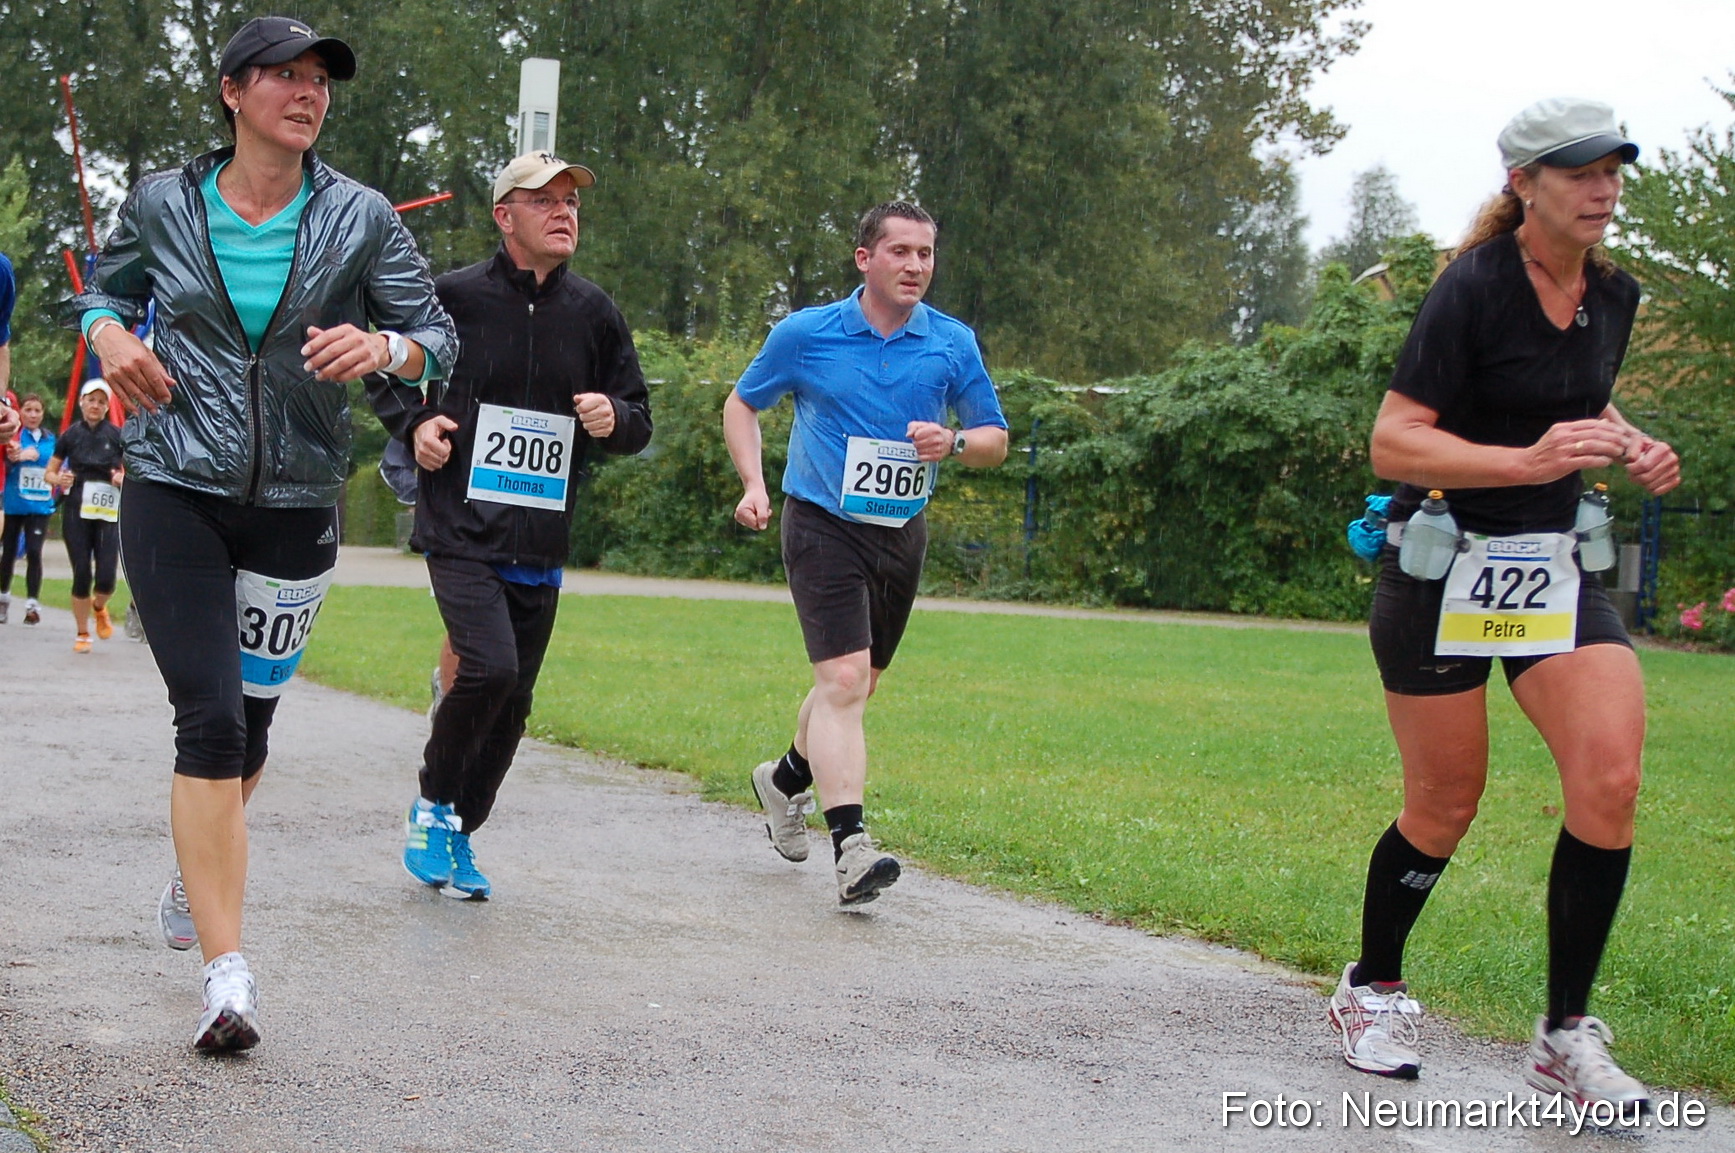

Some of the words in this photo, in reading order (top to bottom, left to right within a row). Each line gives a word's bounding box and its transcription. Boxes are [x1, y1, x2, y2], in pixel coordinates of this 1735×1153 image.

[484, 432, 564, 475] 2908
[497, 475, 545, 494] Thomas
[854, 462, 925, 497] 2966
[92, 492, 114, 507] 669
[865, 501, 910, 516] Stefano
[1487, 541, 1541, 554] BOCK
[1469, 567, 1551, 610] 422
[1483, 620, 1526, 638] Petra
